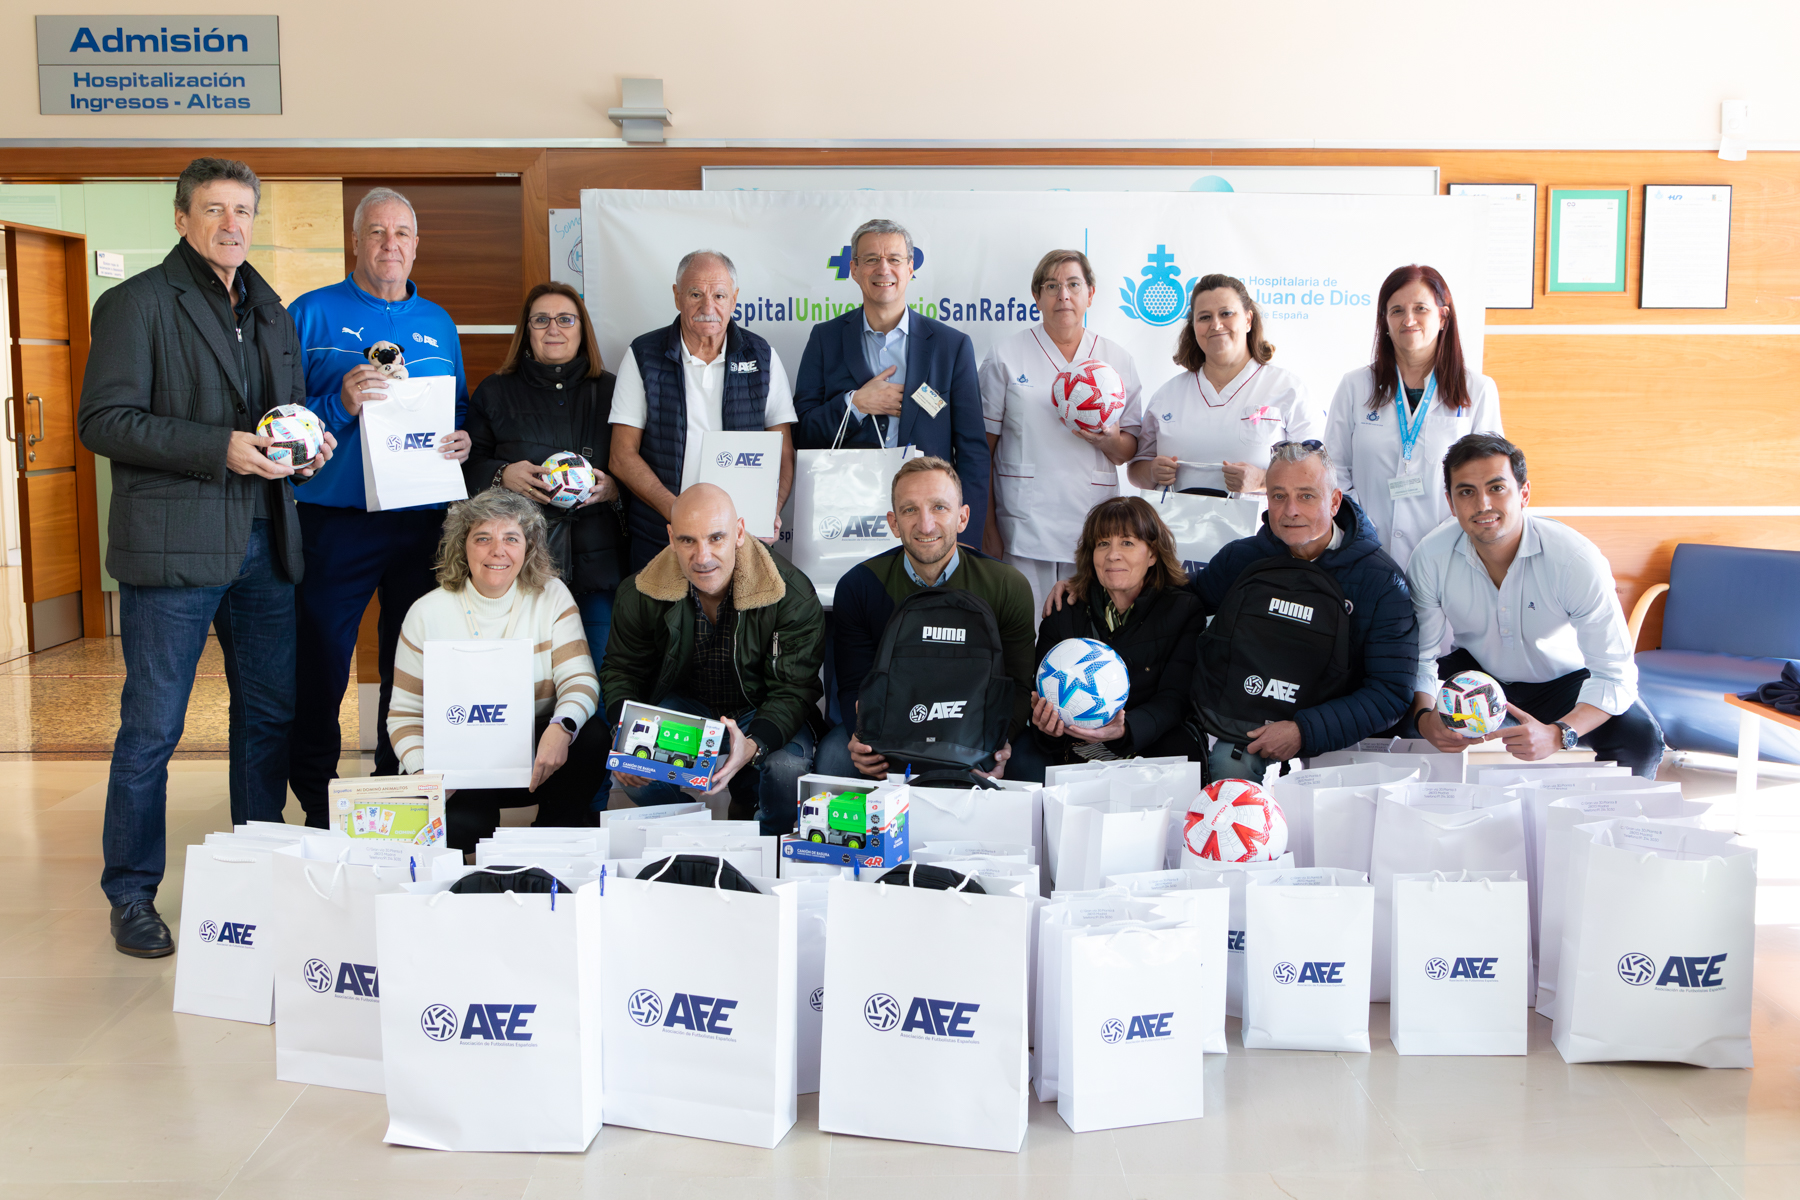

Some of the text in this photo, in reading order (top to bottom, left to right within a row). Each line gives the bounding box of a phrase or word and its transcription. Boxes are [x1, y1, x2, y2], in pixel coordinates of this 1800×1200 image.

[69, 27, 248, 53] Admisión
[73, 72, 246, 91] Hospitalización
[70, 94, 169, 112] Ingresos
[187, 94, 251, 109] Altas
[1249, 276, 1319, 287] Hospitalaria
[1323, 277, 1338, 287] de
[1255, 289, 1371, 306] Juan de Dios
[1272, 310, 1309, 321] España
[404, 432, 436, 450] AFE
[735, 453, 764, 467] AFE
[842, 515, 889, 538] AFE
[1179, 559, 1210, 575] AF
[1269, 597, 1314, 622] PUMA
[922, 626, 966, 642] PUMA
[1262, 678, 1300, 704] AFE
[467, 704, 508, 723] AFE
[927, 700, 968, 721] AFE
[690, 776, 708, 786] 4R
[1211, 804, 1228, 826] MATCH
[865, 856, 883, 867] 4R
[217, 921, 257, 946] AFE
[1228, 930, 1245, 951] FE
[1297, 962, 1346, 983] AFE
[1449, 957, 1498, 979] AFE
[1655, 953, 1728, 988] AFE
[335, 962, 379, 998] AF
[460, 1003, 537, 1041] AFE
[663, 992, 739, 1036] AFE
[901, 997, 981, 1038] AFE
[662, 1027, 684, 1036] Asociación
[692, 1032, 715, 1040] Futbolistas
[900, 1032, 923, 1040] Asociación
[1126, 1012, 1175, 1041] AFE
